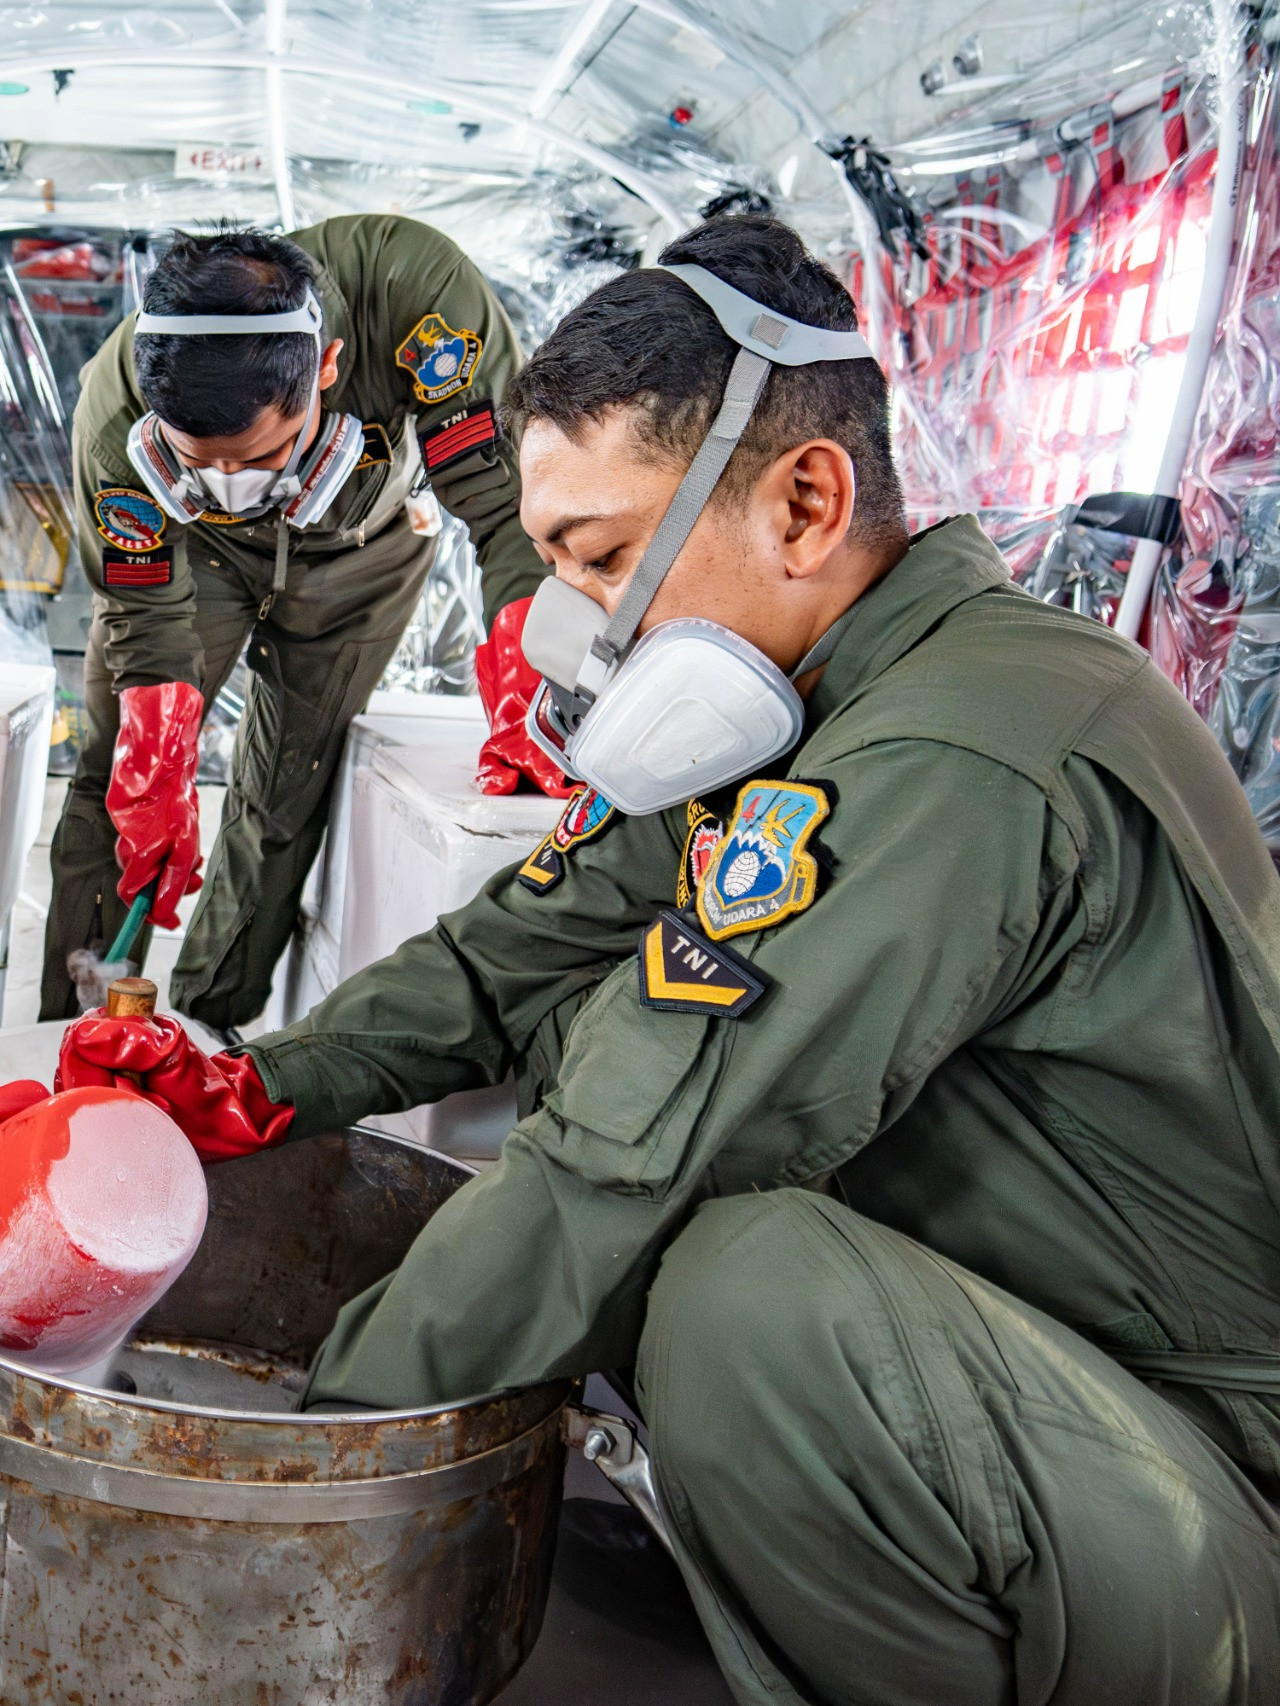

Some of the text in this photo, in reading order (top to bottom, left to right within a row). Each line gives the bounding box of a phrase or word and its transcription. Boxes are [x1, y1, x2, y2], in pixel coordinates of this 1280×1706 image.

[441, 410, 469, 430] TNI
[107, 530, 153, 549] WALET
[125, 556, 151, 564] TNI
[742, 795, 762, 823] 4
[723, 905, 767, 926] UDARA
[769, 898, 780, 912] 4
[669, 935, 719, 980] TNI
